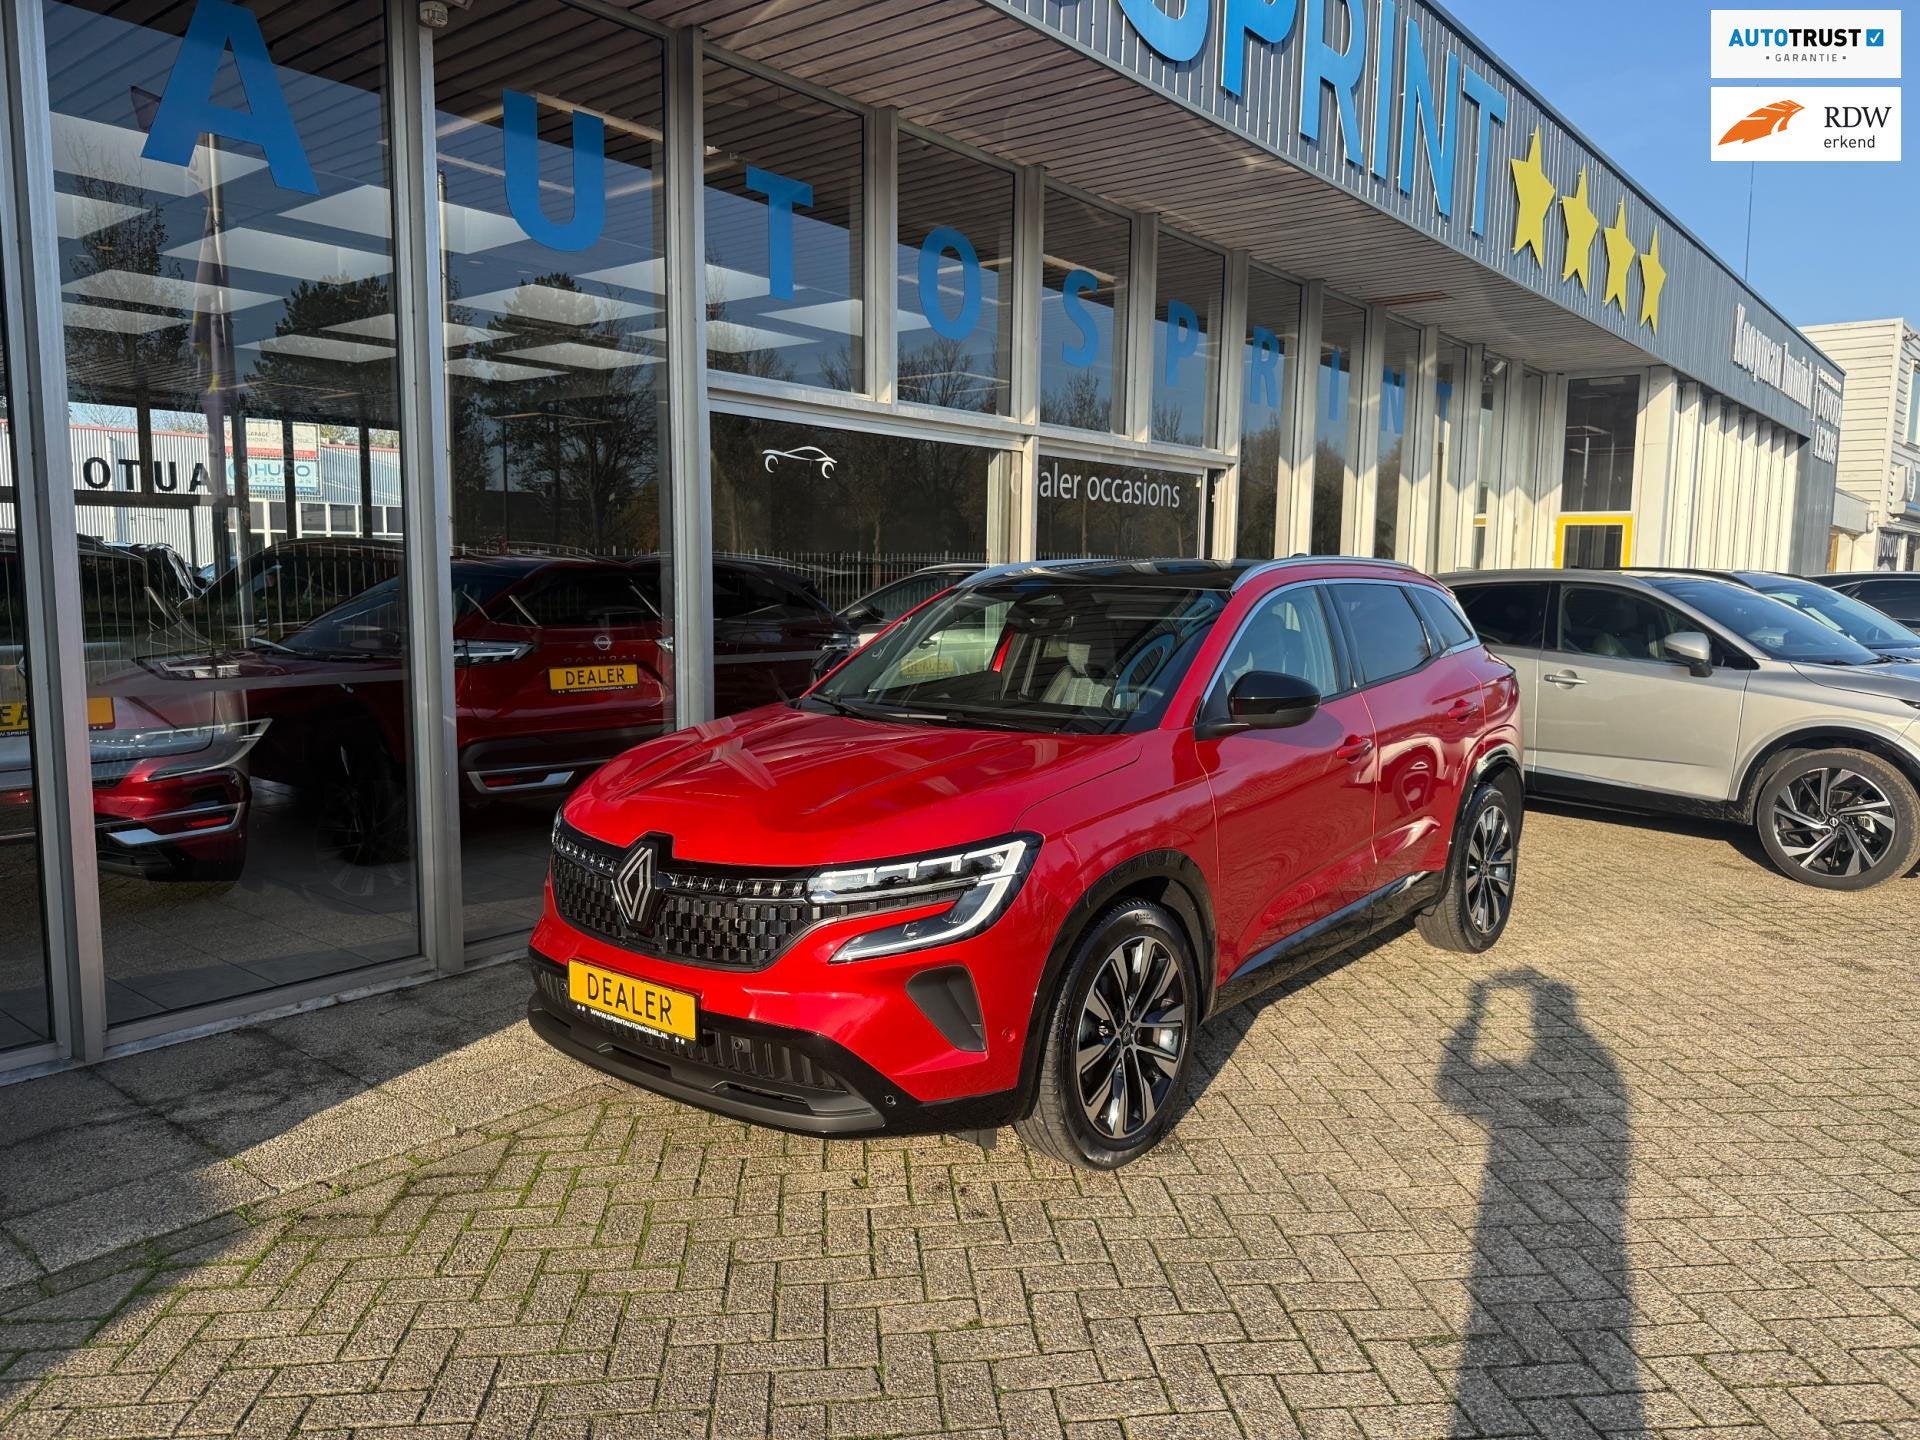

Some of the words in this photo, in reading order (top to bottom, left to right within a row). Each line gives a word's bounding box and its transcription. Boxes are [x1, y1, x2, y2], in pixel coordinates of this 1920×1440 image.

[1734, 303, 1783, 390] Koopman
[1814, 424, 1838, 464] LEXUS
[254, 463, 311, 477] HUO
[1087, 474, 1180, 508] occasions
[565, 667, 626, 686] DEALER
[587, 972, 673, 1026] DEALER
